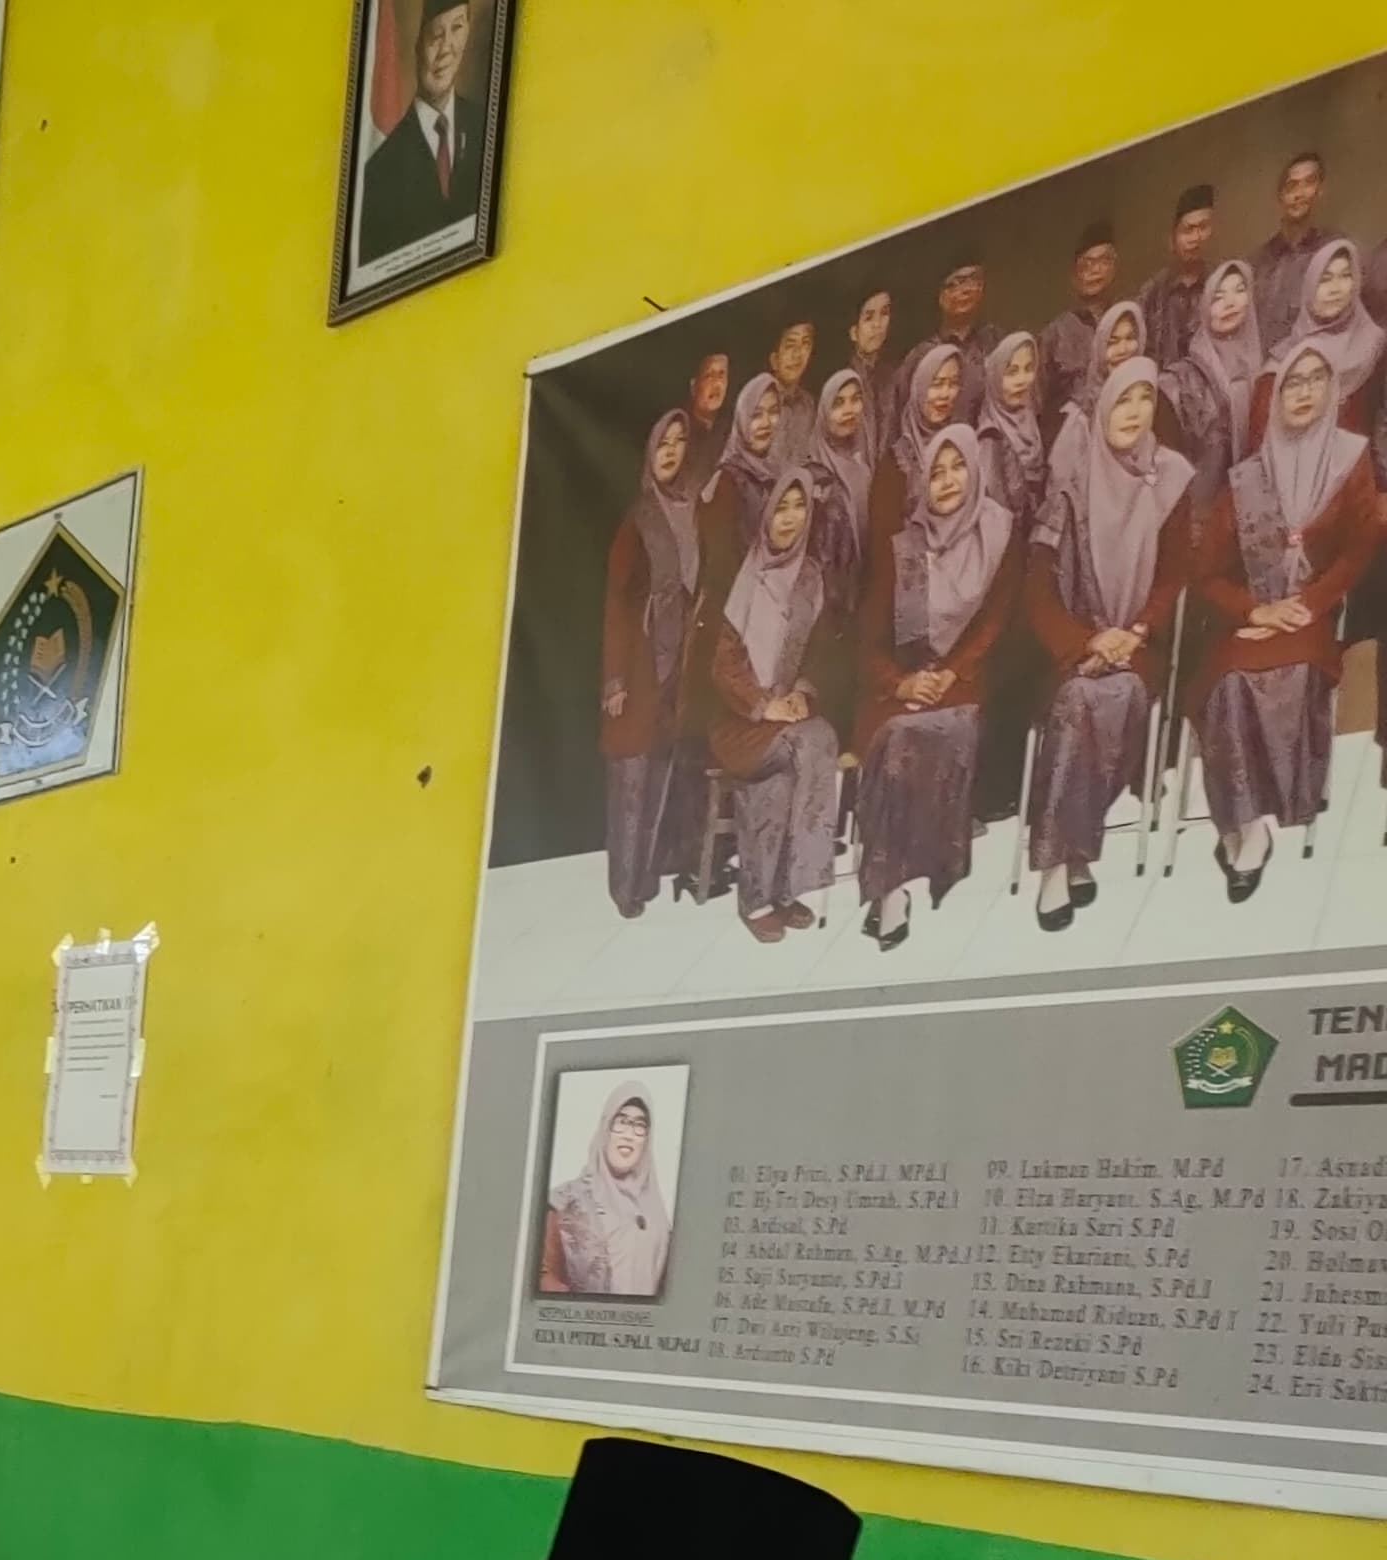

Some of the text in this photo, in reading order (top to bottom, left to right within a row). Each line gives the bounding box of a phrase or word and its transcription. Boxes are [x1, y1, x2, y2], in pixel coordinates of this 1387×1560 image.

[1173, 1156, 1226, 1179] M.Pd
[1130, 1217, 1176, 1239] S.Pd
[1367, 1219, 1387, 1242] O
